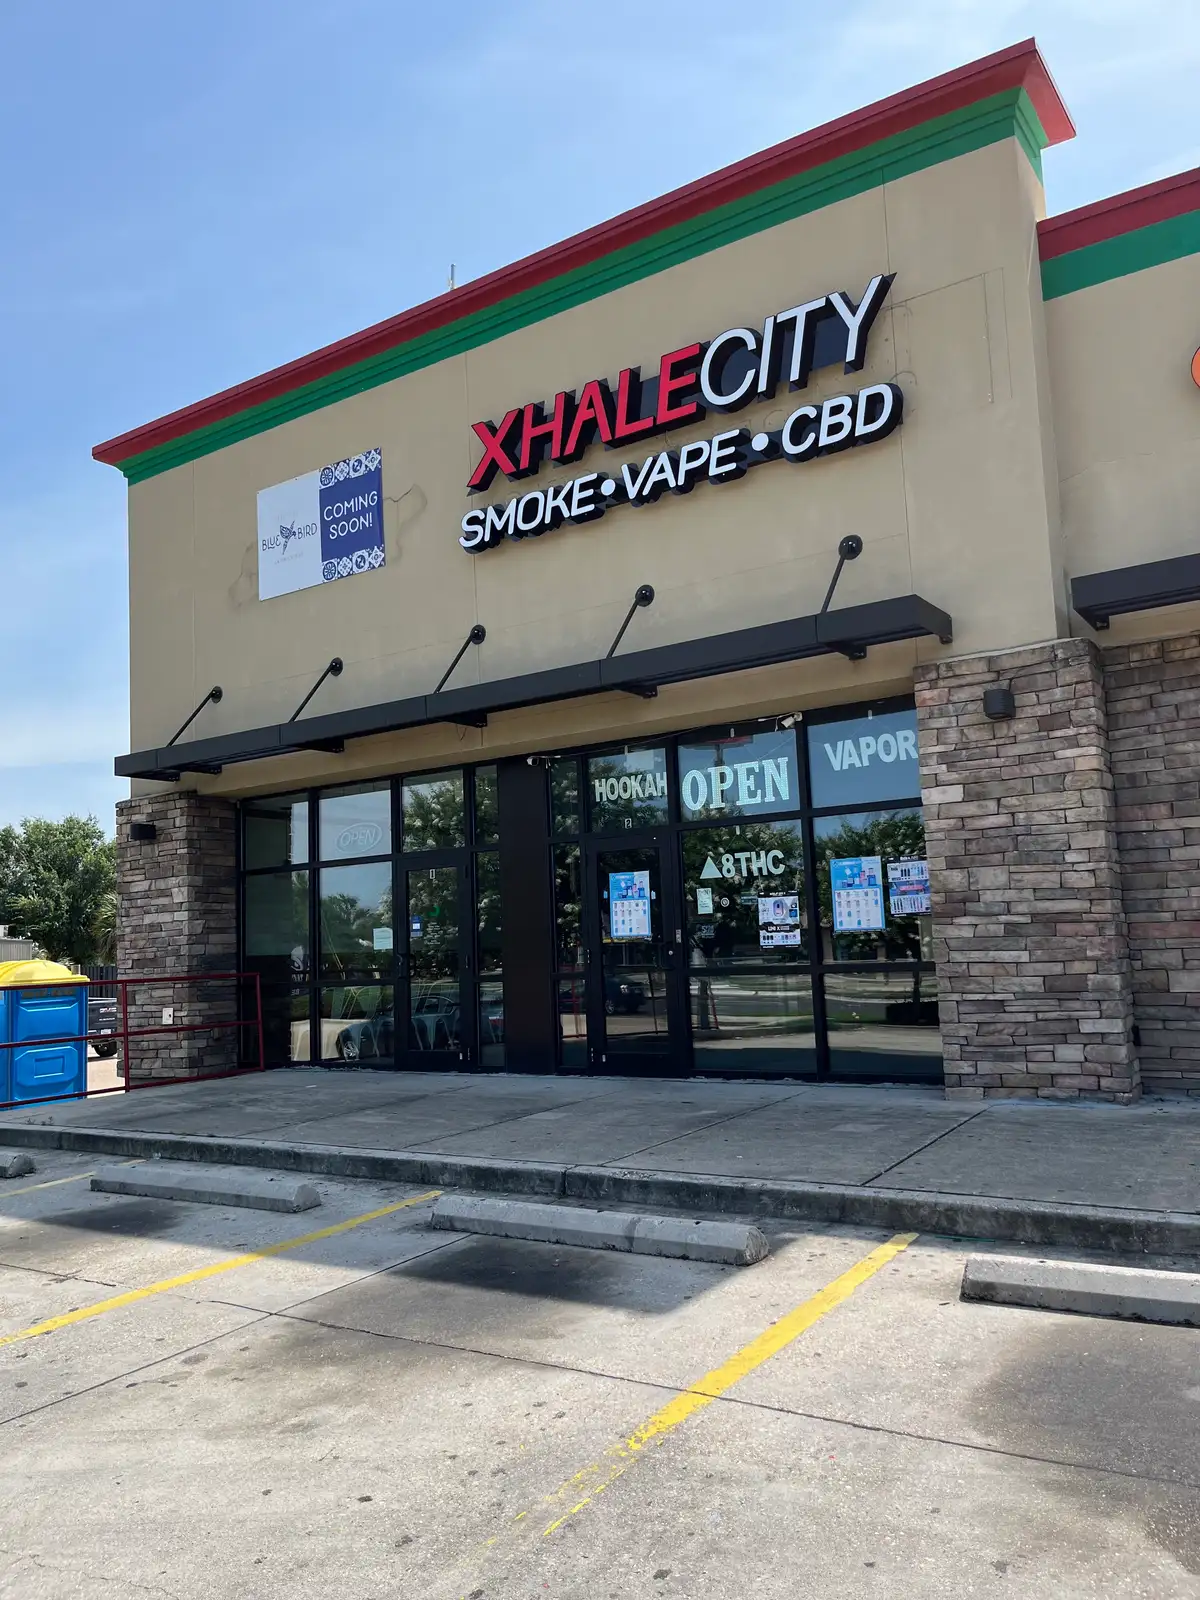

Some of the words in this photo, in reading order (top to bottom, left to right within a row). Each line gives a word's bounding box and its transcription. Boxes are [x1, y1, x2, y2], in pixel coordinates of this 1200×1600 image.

[781, 384, 894, 455] CBD
[323, 491, 378, 521] COMING
[262, 534, 281, 552] BLUE
[297, 522, 318, 540] BIRD
[329, 512, 373, 540] SOON!
[824, 729, 919, 772] VAPOR
[594, 771, 668, 802] HOOKAH
[682, 757, 790, 811] OPEN
[340, 828, 376, 848] OPEN
